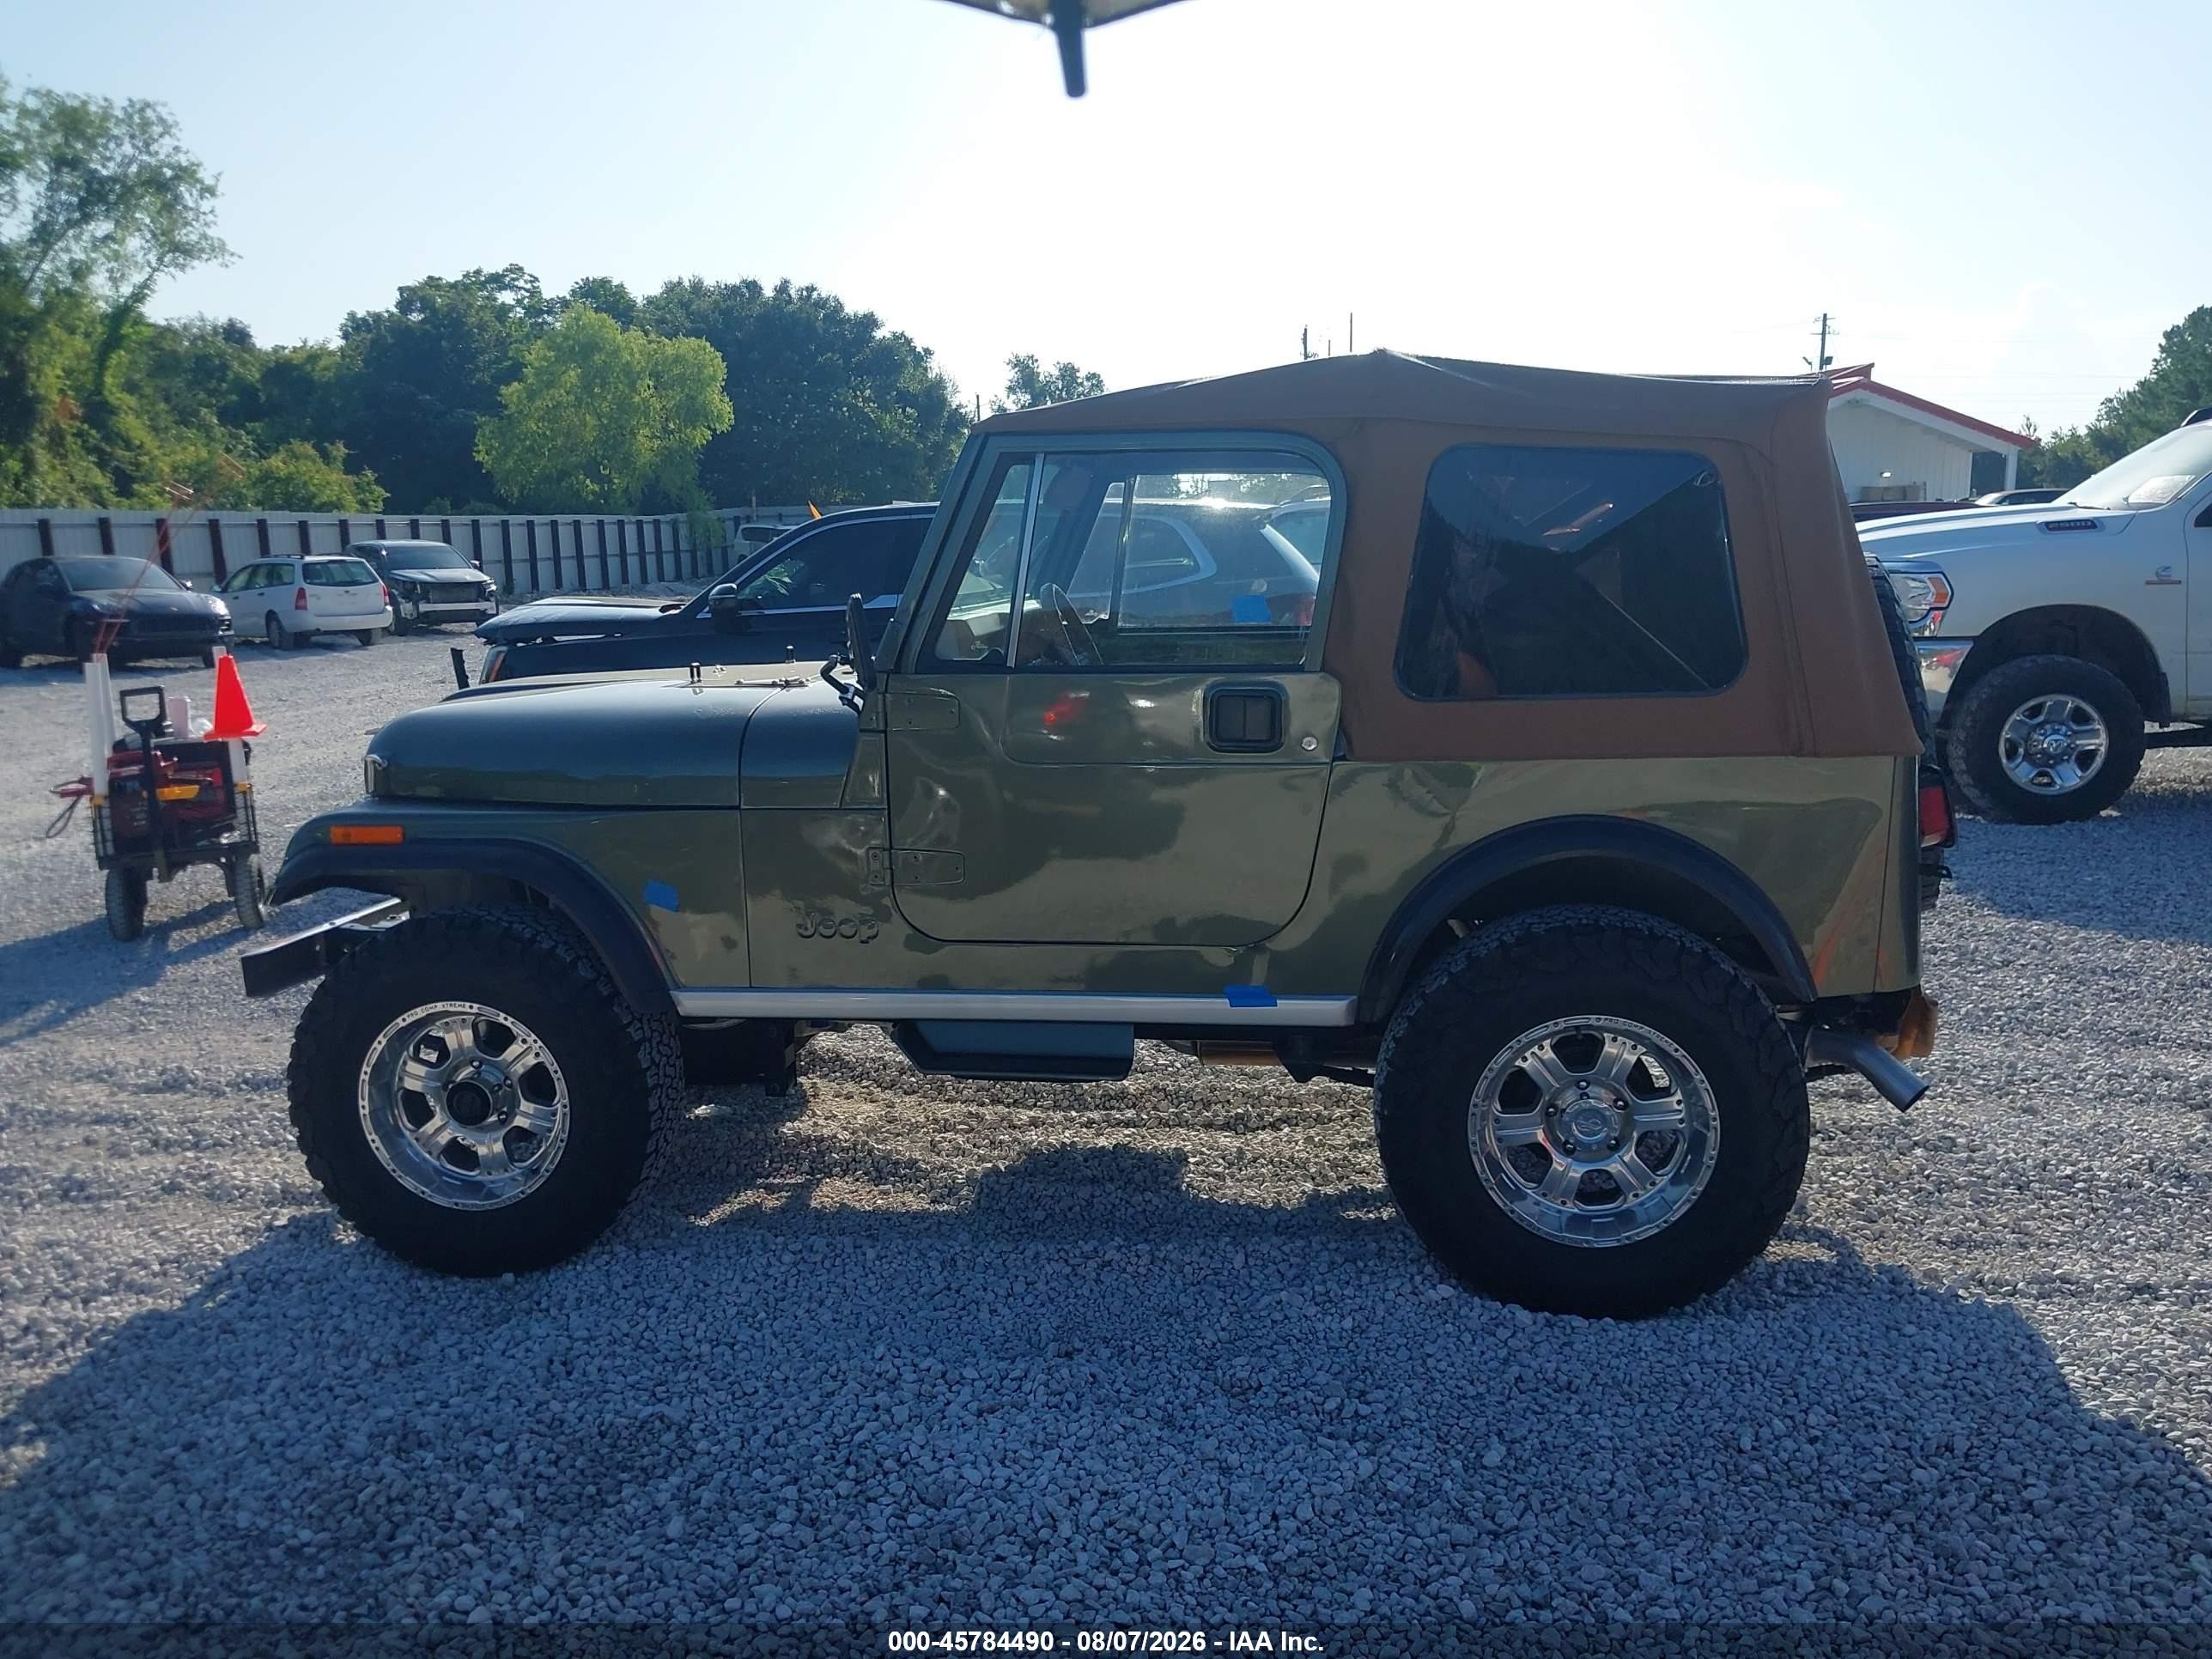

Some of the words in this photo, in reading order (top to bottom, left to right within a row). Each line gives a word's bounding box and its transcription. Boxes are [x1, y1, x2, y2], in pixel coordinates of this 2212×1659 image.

[796, 910, 880, 945] Jeep
[406, 1010, 419, 1019] PRO
[421, 1004, 438, 1013] COMP
[1622, 1020, 1644, 1031] COMP
